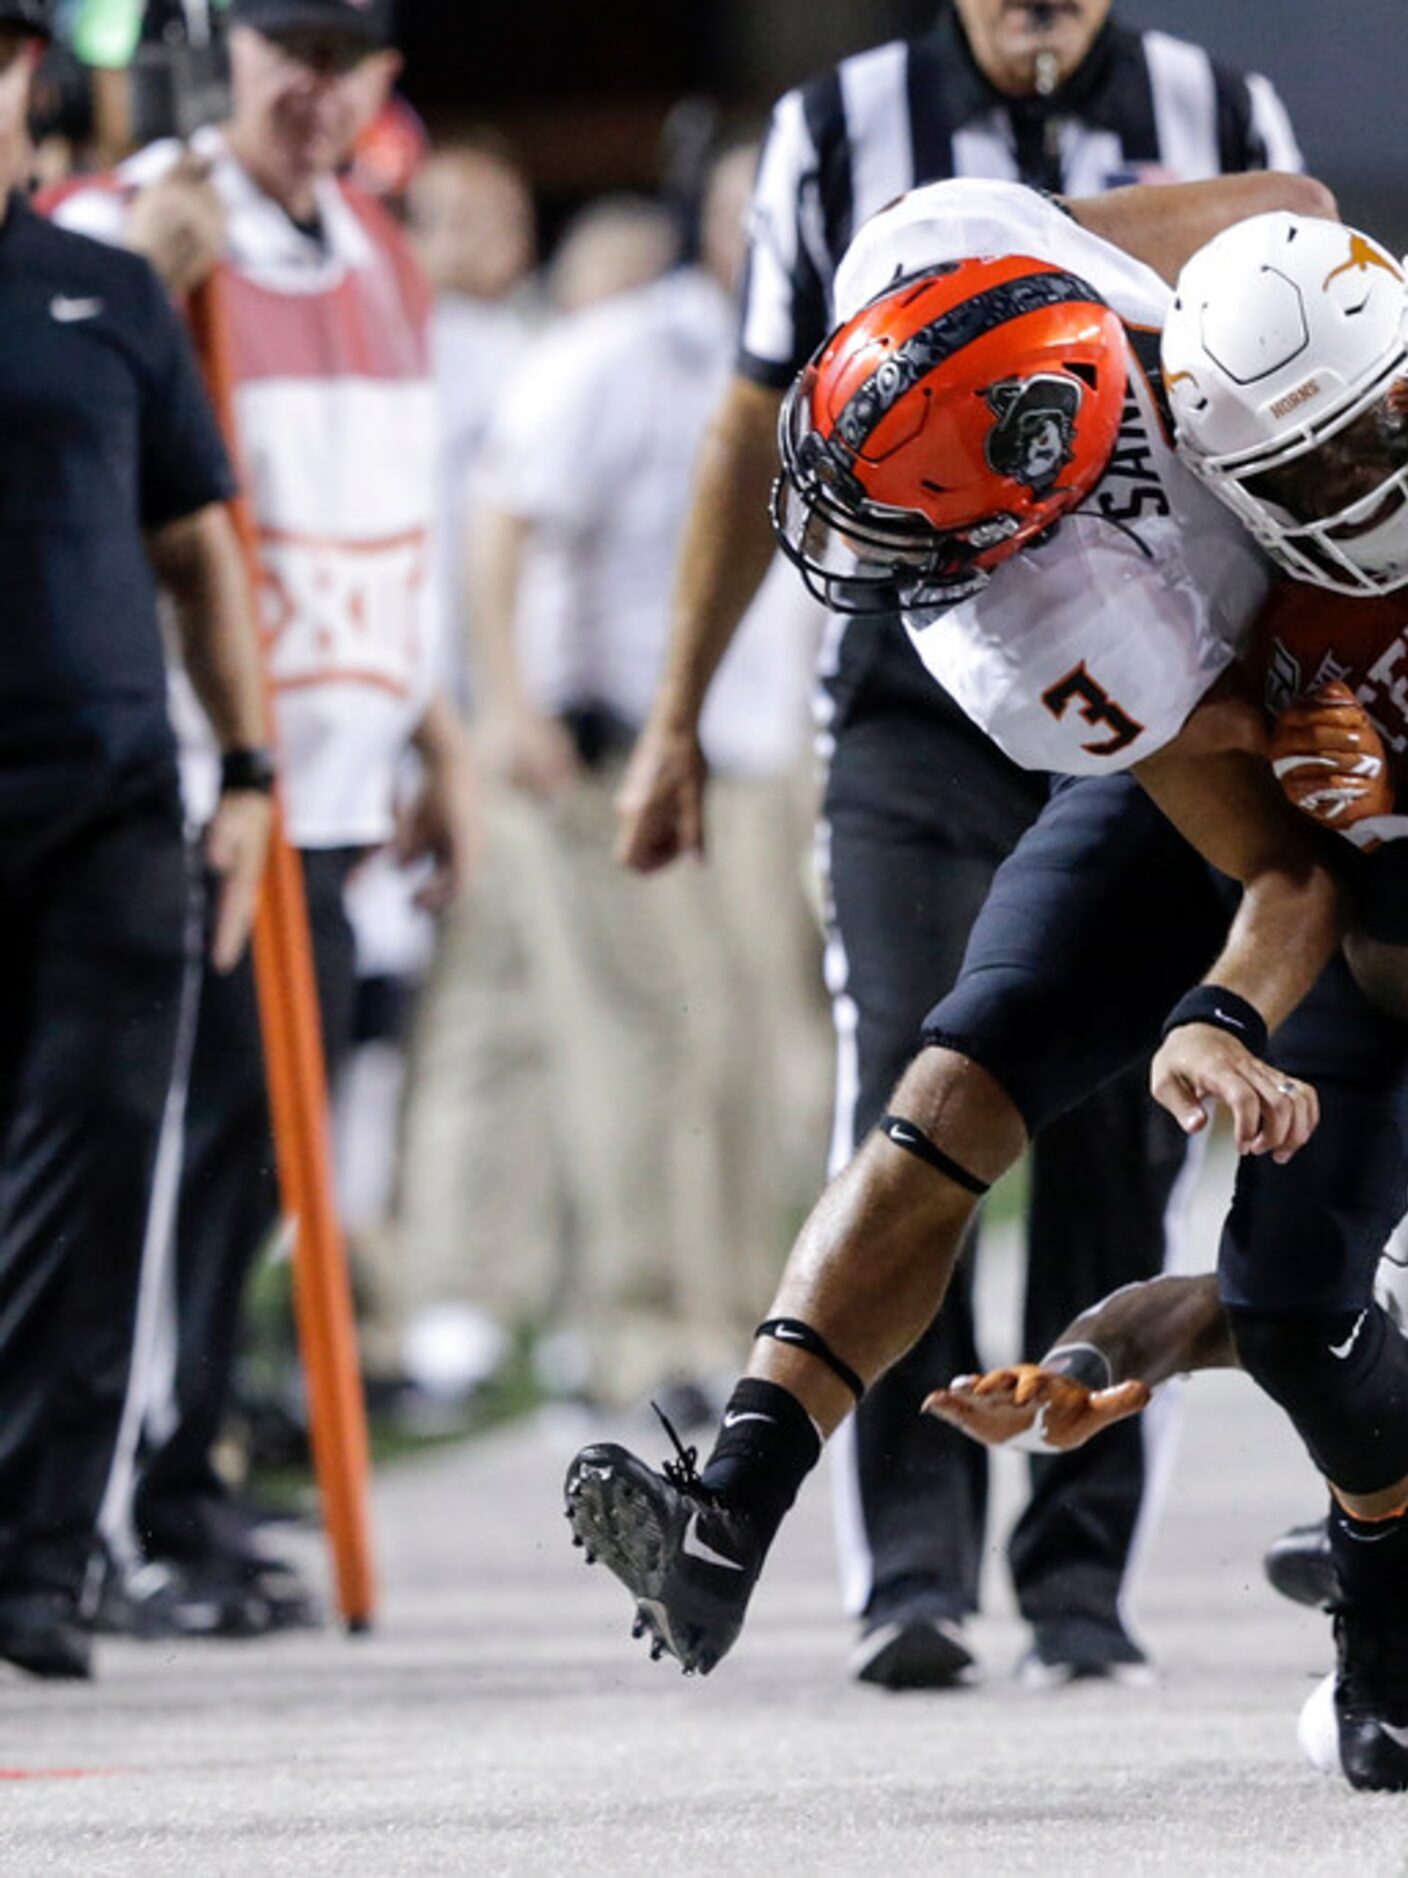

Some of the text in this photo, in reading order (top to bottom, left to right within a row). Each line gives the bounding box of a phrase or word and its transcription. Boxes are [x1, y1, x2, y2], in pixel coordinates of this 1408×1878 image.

[1098, 374, 1170, 520] SAN
[1269, 378, 1321, 420] HORNS
[1040, 659, 1146, 757] 3
